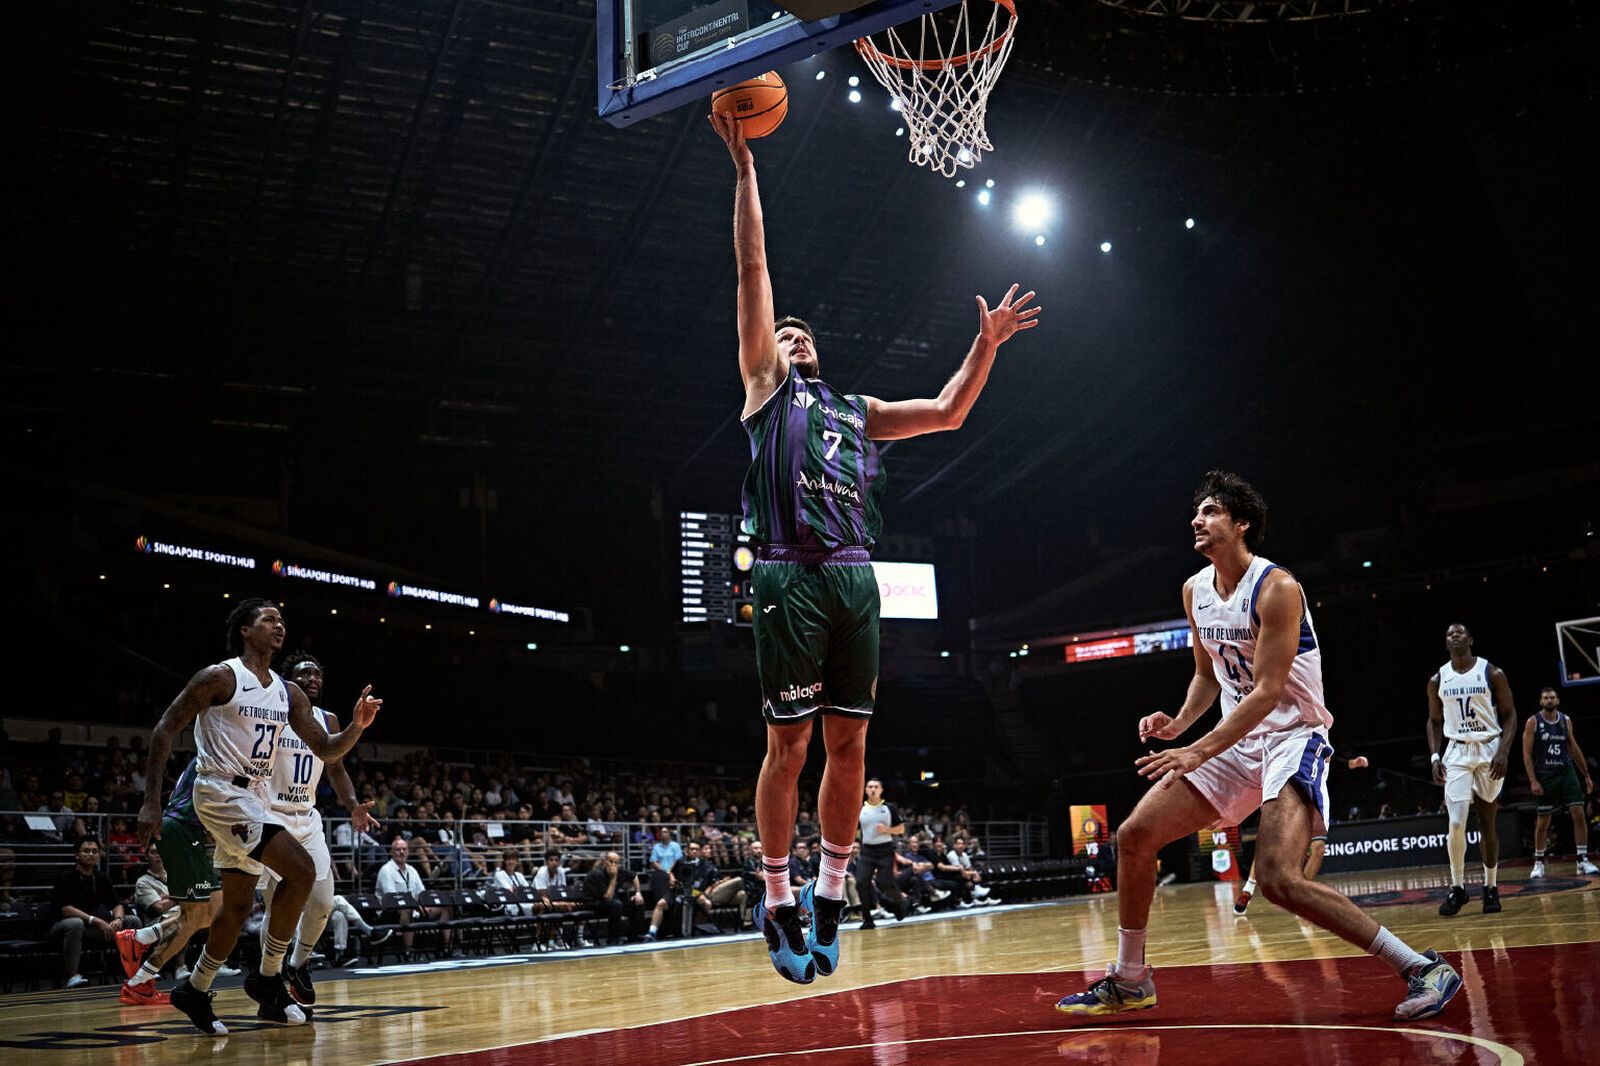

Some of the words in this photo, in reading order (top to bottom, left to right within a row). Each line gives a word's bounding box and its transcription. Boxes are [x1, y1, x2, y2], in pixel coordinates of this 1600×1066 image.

[823, 430, 842, 460] 7
[153, 542, 203, 559] SINGAPORE
[204, 551, 237, 565] SPORTS
[237, 557, 256, 568] HUB
[287, 565, 331, 583] SINGAPORE
[331, 573, 359, 587] SPORTS
[360, 579, 376, 590] HUB
[402, 585, 439, 601] SINGAPORE
[440, 592, 464, 605] SPORTS
[1216, 627, 1225, 640] DE
[239, 706, 262, 718] PETRO
[262, 708, 270, 720] DE
[1456, 696, 1476, 720] 14
[1460, 720, 1479, 728] VISIT
[251, 724, 276, 759] 23
[278, 738, 299, 750] PETRO
[1548, 744, 1561, 755] 45
[294, 753, 313, 784] 10
[1211, 832, 1228, 845] VS
[1323, 838, 1400, 857] SINGAPORE
[1085, 842, 1099, 856] VS
